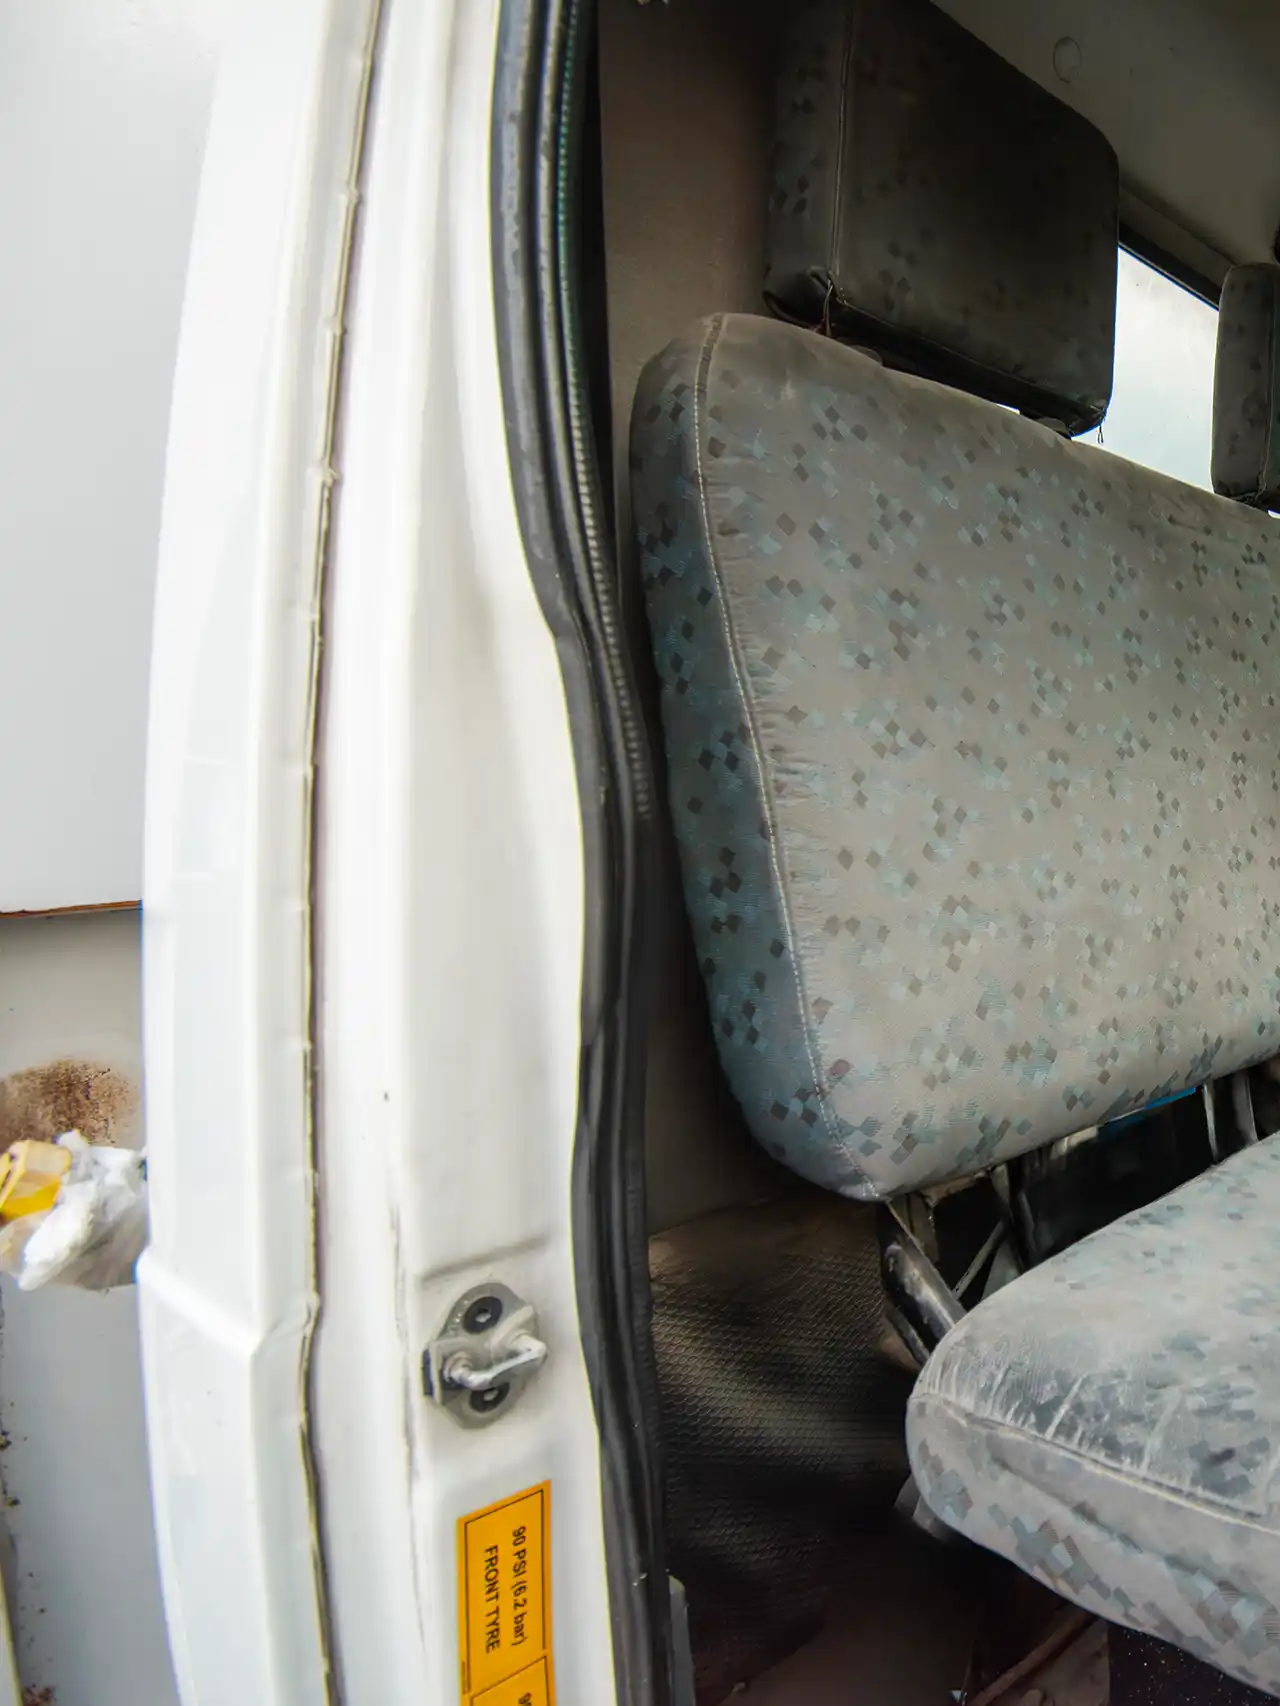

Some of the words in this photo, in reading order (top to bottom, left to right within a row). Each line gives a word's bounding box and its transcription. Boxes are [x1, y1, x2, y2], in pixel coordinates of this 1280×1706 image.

[512, 1525, 526, 1546] 90
[484, 1545, 499, 1602] FRONT
[512, 1548, 527, 1578] PSI
[511, 1580, 527, 1610] (6.2
[485, 1606, 500, 1654] TYRE
[511, 1612, 528, 1646] bar)
